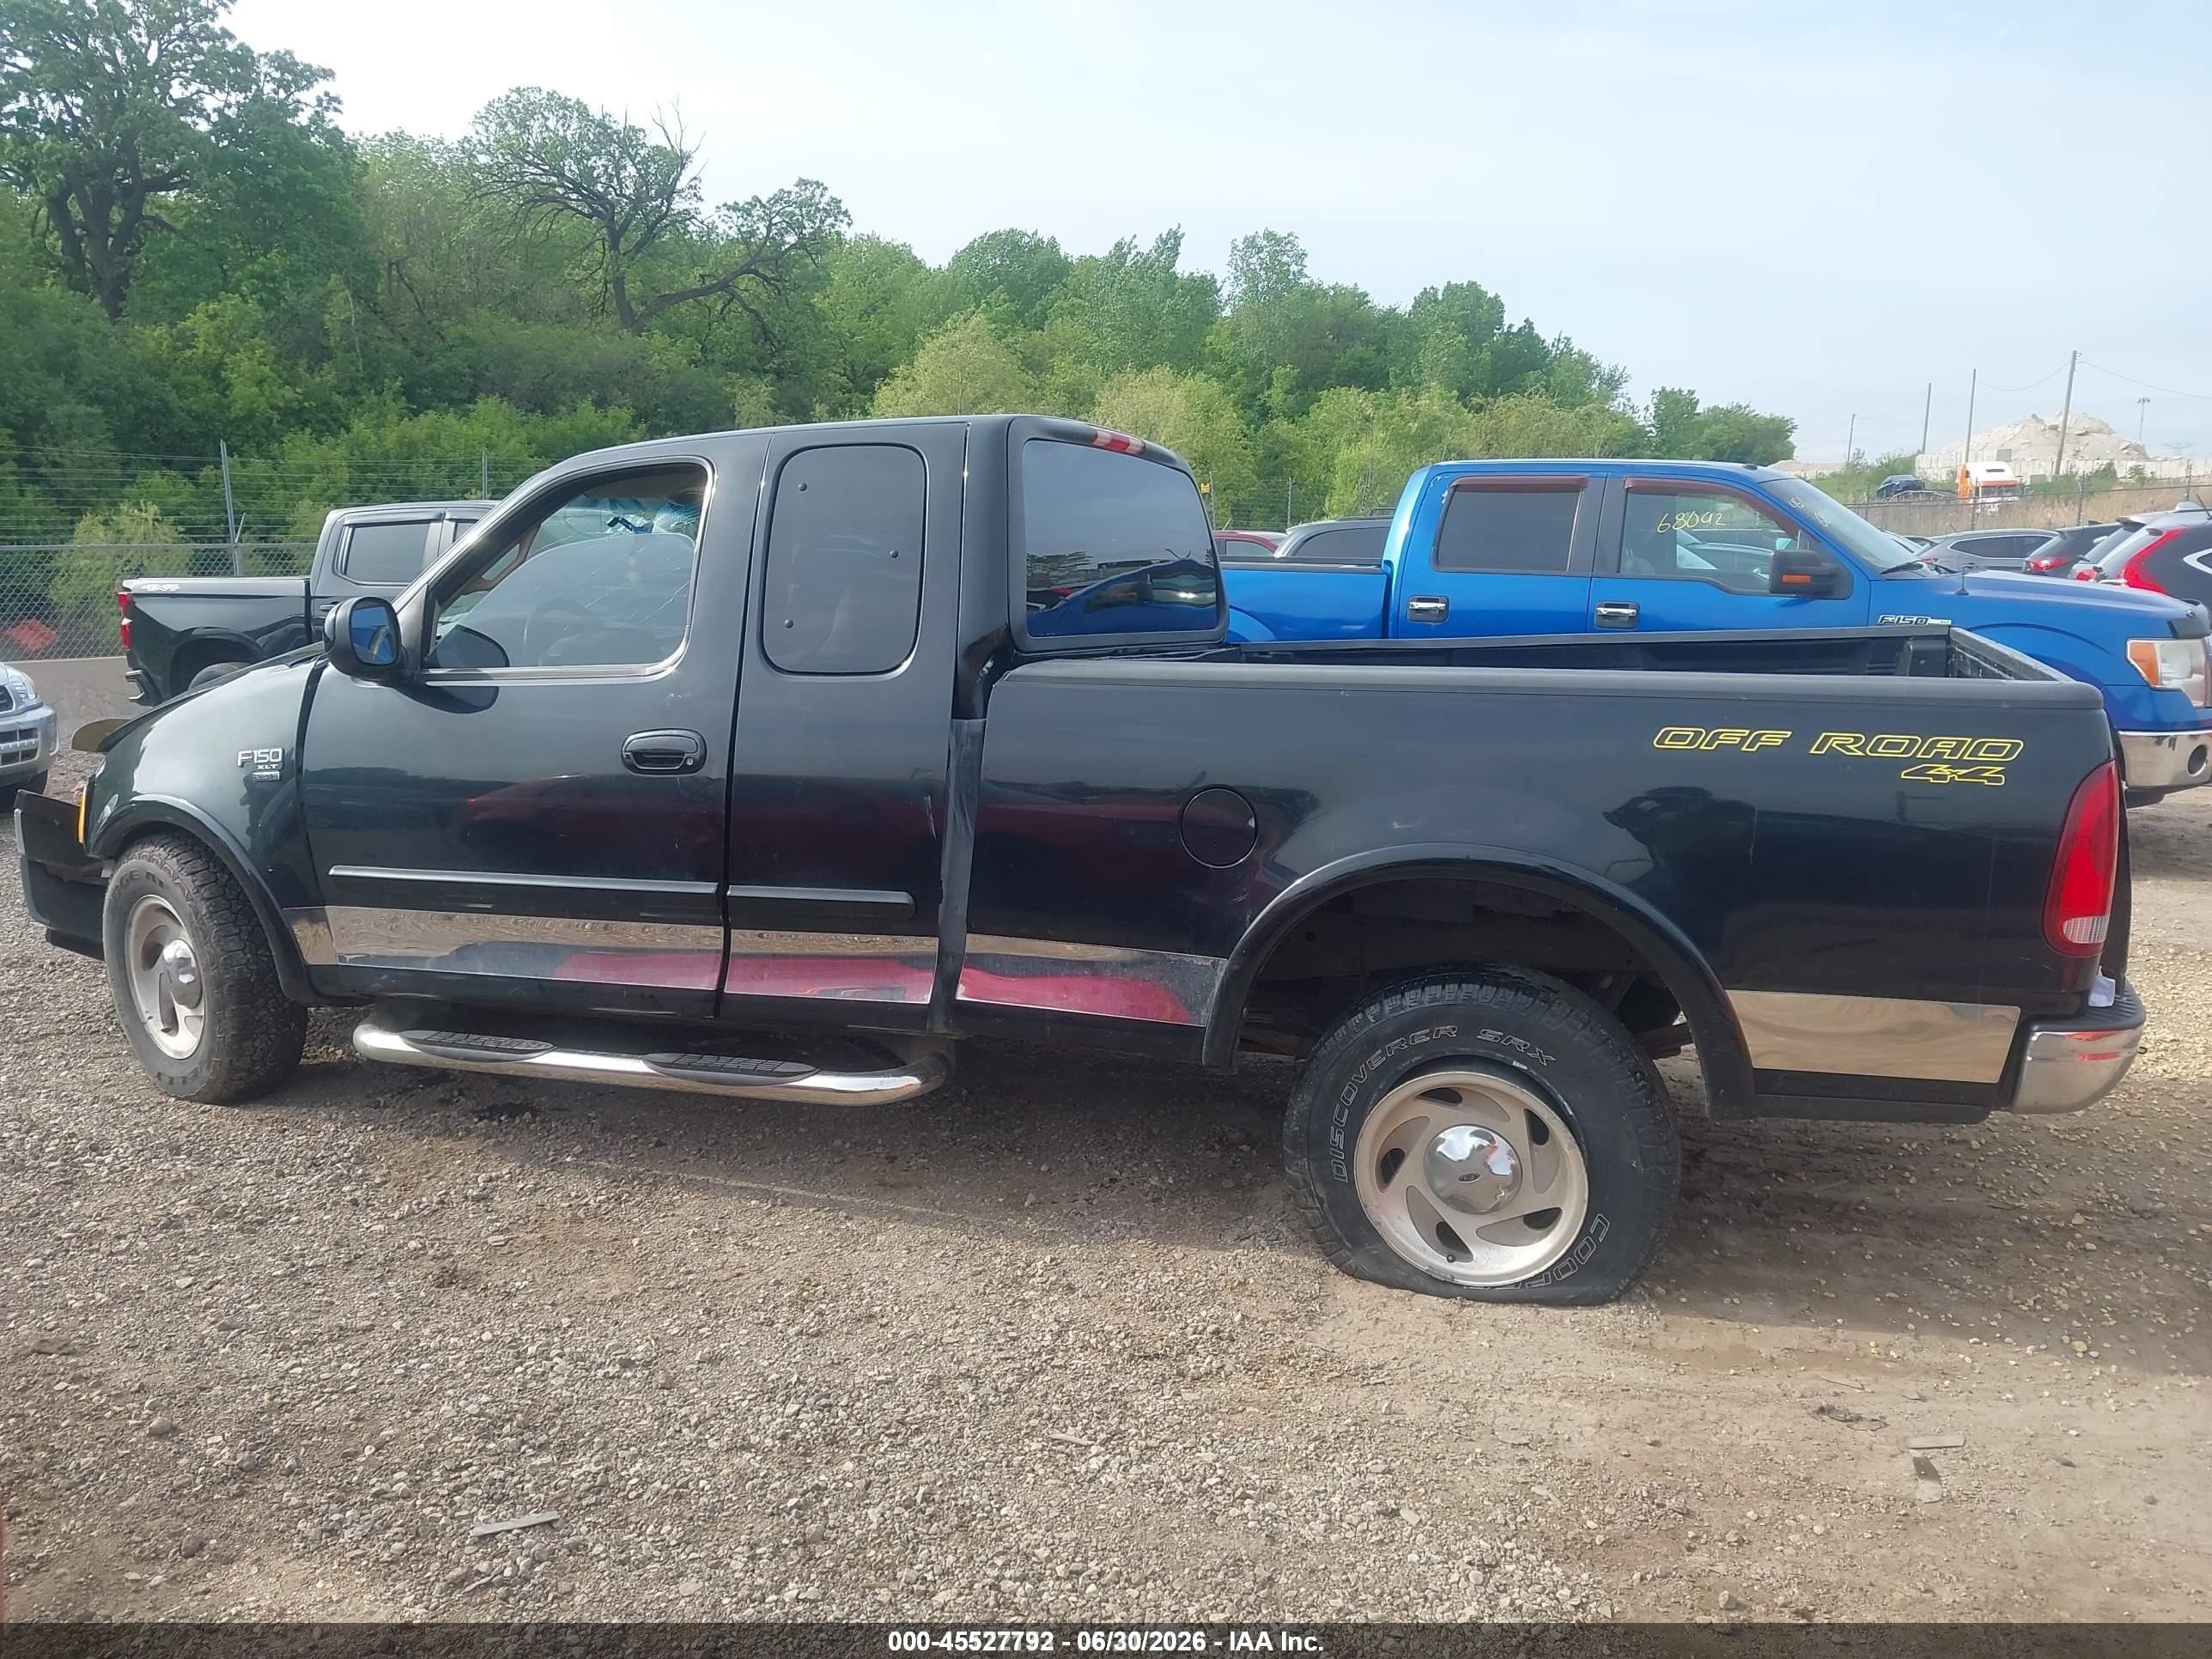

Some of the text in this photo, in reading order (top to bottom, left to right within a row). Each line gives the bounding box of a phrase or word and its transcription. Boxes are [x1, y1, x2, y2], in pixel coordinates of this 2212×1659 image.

[1656, 510, 1728, 533] 68092
[1652, 726, 2025, 762] OFF ROAD
[1329, 1025, 1557, 1183] DISCOVERER SRX
